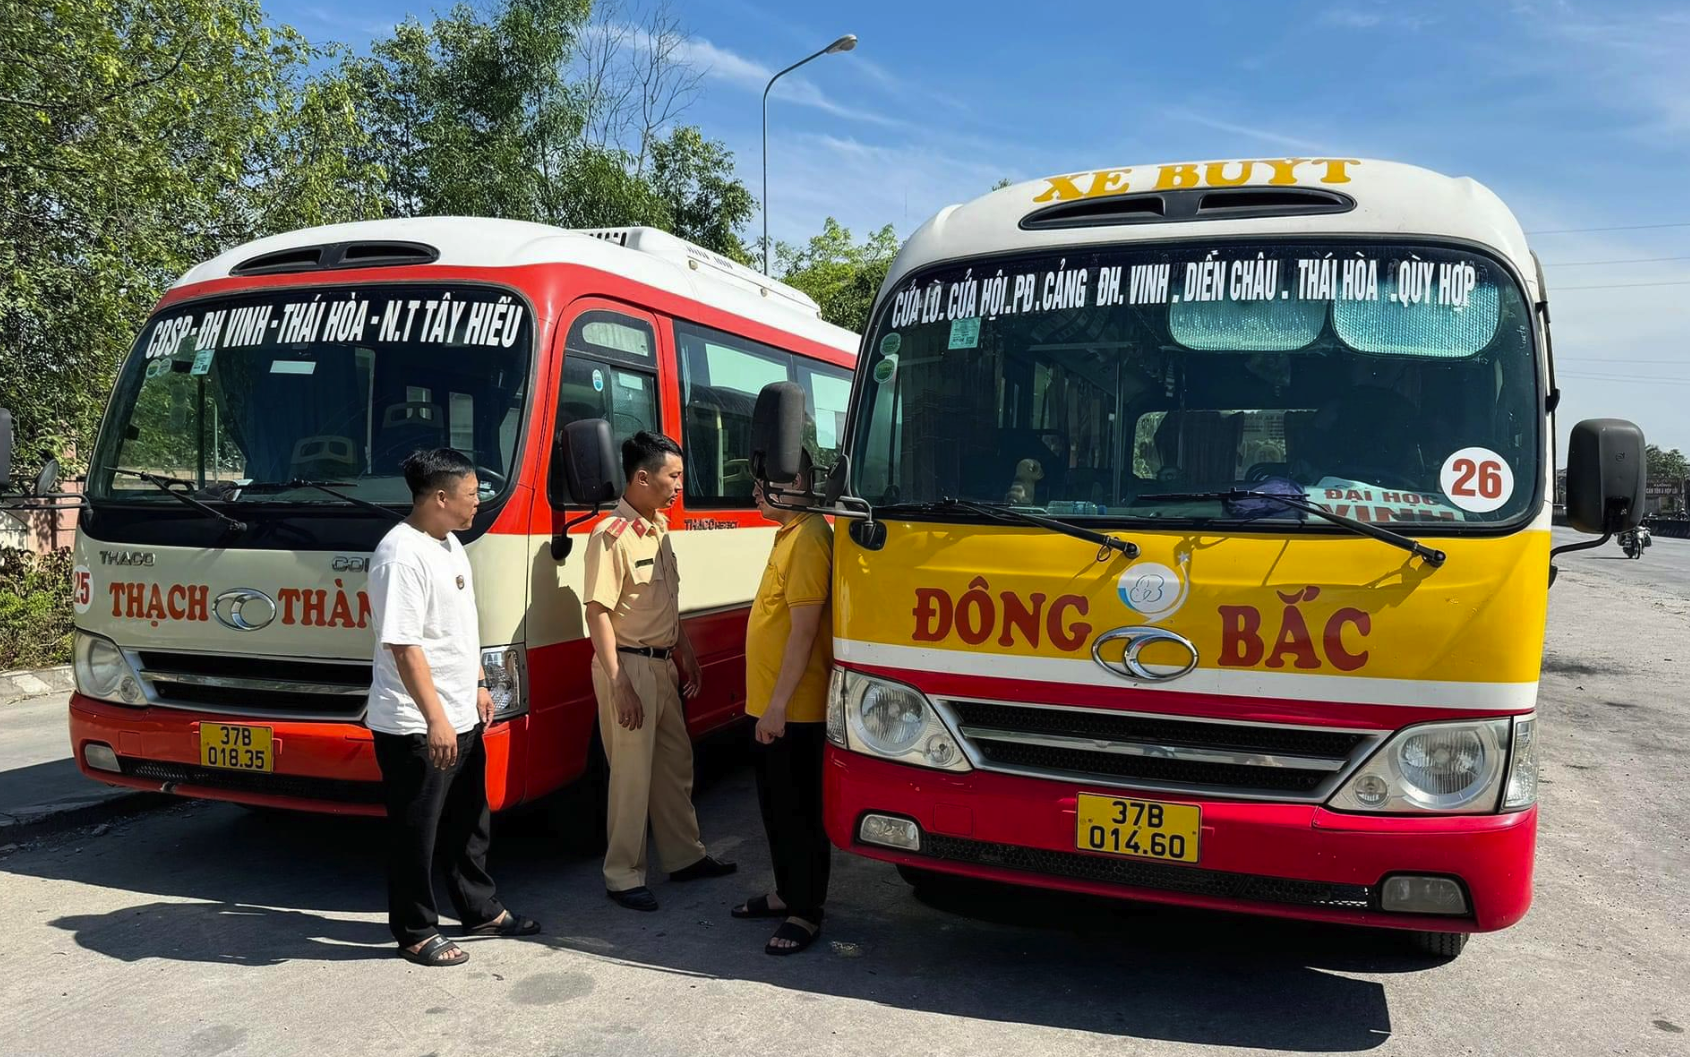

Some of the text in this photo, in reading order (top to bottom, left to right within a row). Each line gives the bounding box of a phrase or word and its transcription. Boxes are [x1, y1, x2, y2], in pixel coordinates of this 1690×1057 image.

[1032, 168, 1132, 203] XE
[1042, 257, 1088, 312] CẢNG
[1230, 252, 1278, 302] CHÂU
[1298, 252, 1337, 301] THÁI
[1342, 251, 1379, 301] HÒA
[222, 305, 273, 348] VINH
[276, 293, 326, 344] THÁI
[322, 292, 369, 342] HÒA
[419, 292, 462, 344] TÂY
[463, 295, 524, 348] HIẾU
[1451, 458, 1502, 500] 26
[99, 550, 156, 567] THACO
[73, 571, 91, 605] 25
[109, 581, 209, 627] THẠCH
[910, 575, 1372, 671] ĐÔNG BẮC
[220, 726, 252, 747] 37B
[208, 746, 265, 769] 018.35
[1111, 800, 1164, 829] 37B
[1089, 825, 1186, 859] 014.60
